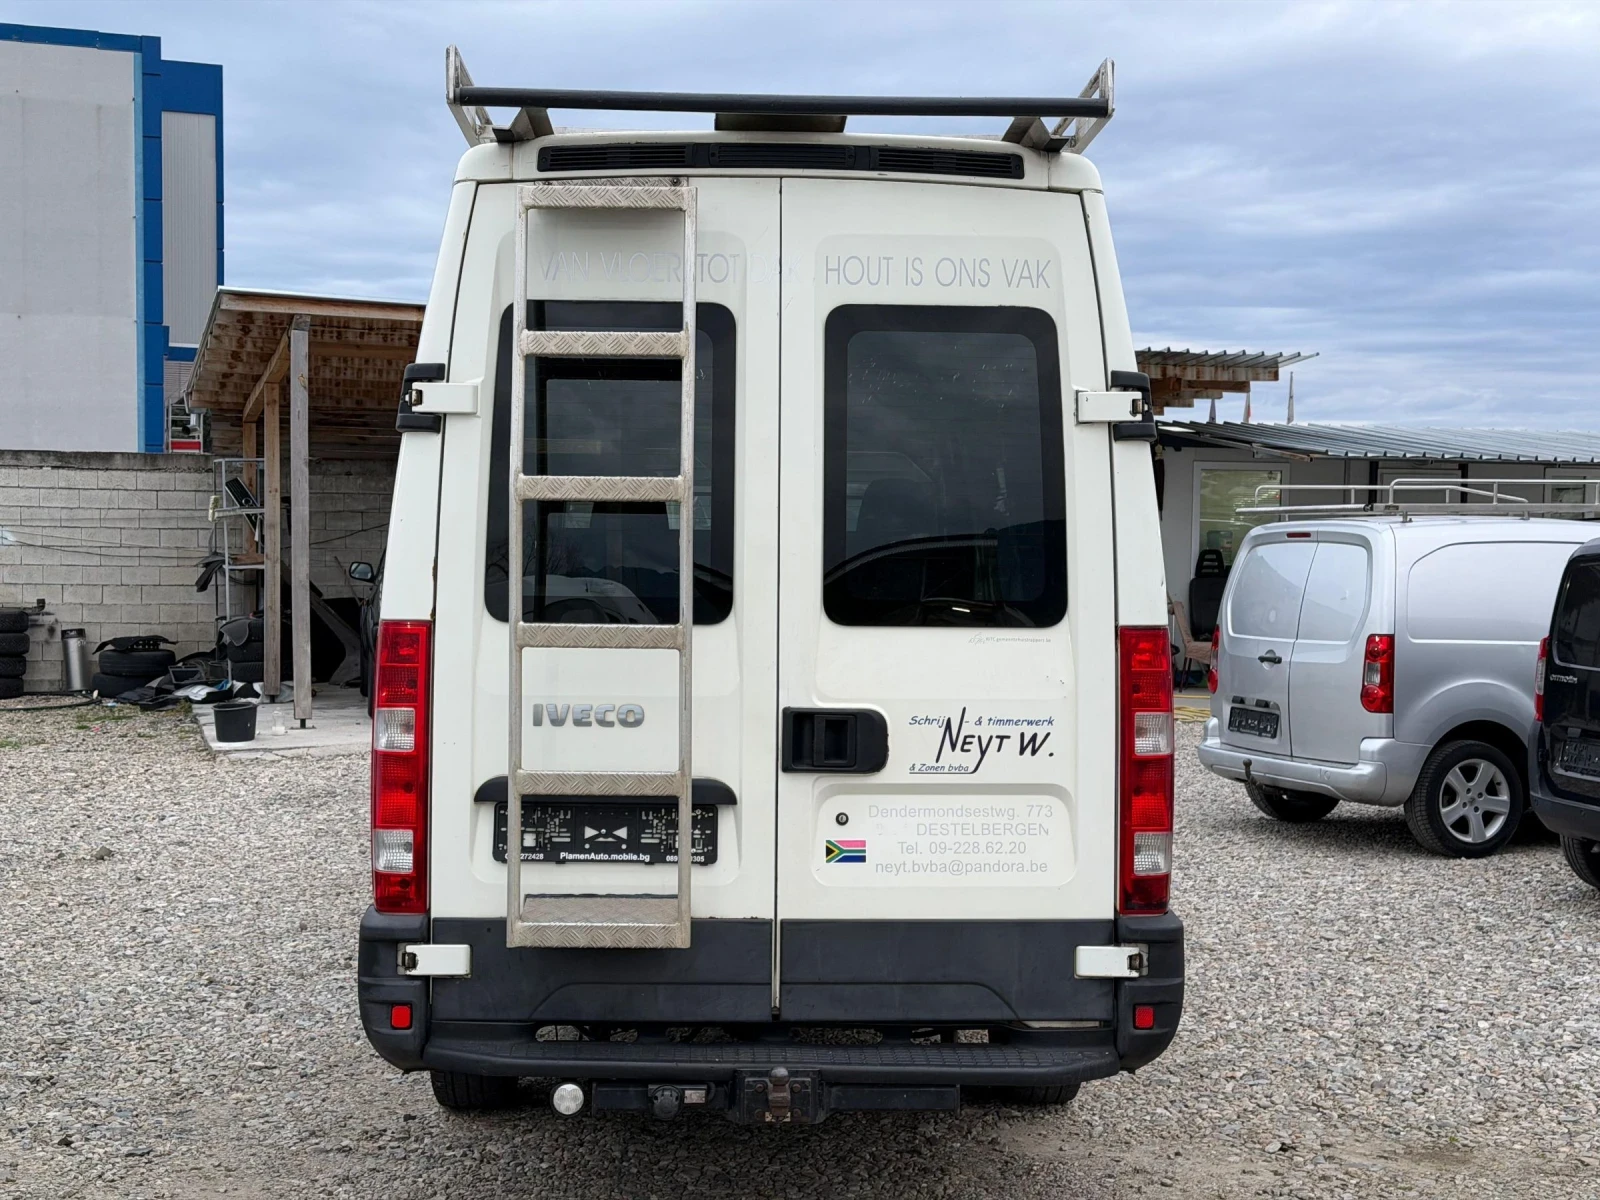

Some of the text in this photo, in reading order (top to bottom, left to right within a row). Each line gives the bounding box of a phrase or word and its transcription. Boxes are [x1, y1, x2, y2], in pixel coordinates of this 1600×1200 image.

[538, 251, 590, 282] VAN
[697, 253, 740, 284] TOT
[825, 255, 894, 287] HOUT
[905, 256, 924, 287] IS
[935, 257, 991, 288] ONS
[1001, 258, 1052, 289] VAK
[532, 703, 645, 729] IVECO
[987, 716, 1055, 727] timmerwerk
[918, 763, 946, 772] Zonen
[949, 763, 969, 772] bvba
[868, 804, 1053, 820] Dendermondsestwg. 773
[916, 823, 1050, 836] DESTELBERGEN
[897, 841, 1027, 855] Tel. 09-228.62.20
[560, 852, 650, 862] PlamenAuto.mobile.bg
[875, 860, 1048, 876] neyt.bvba@pandora.be
